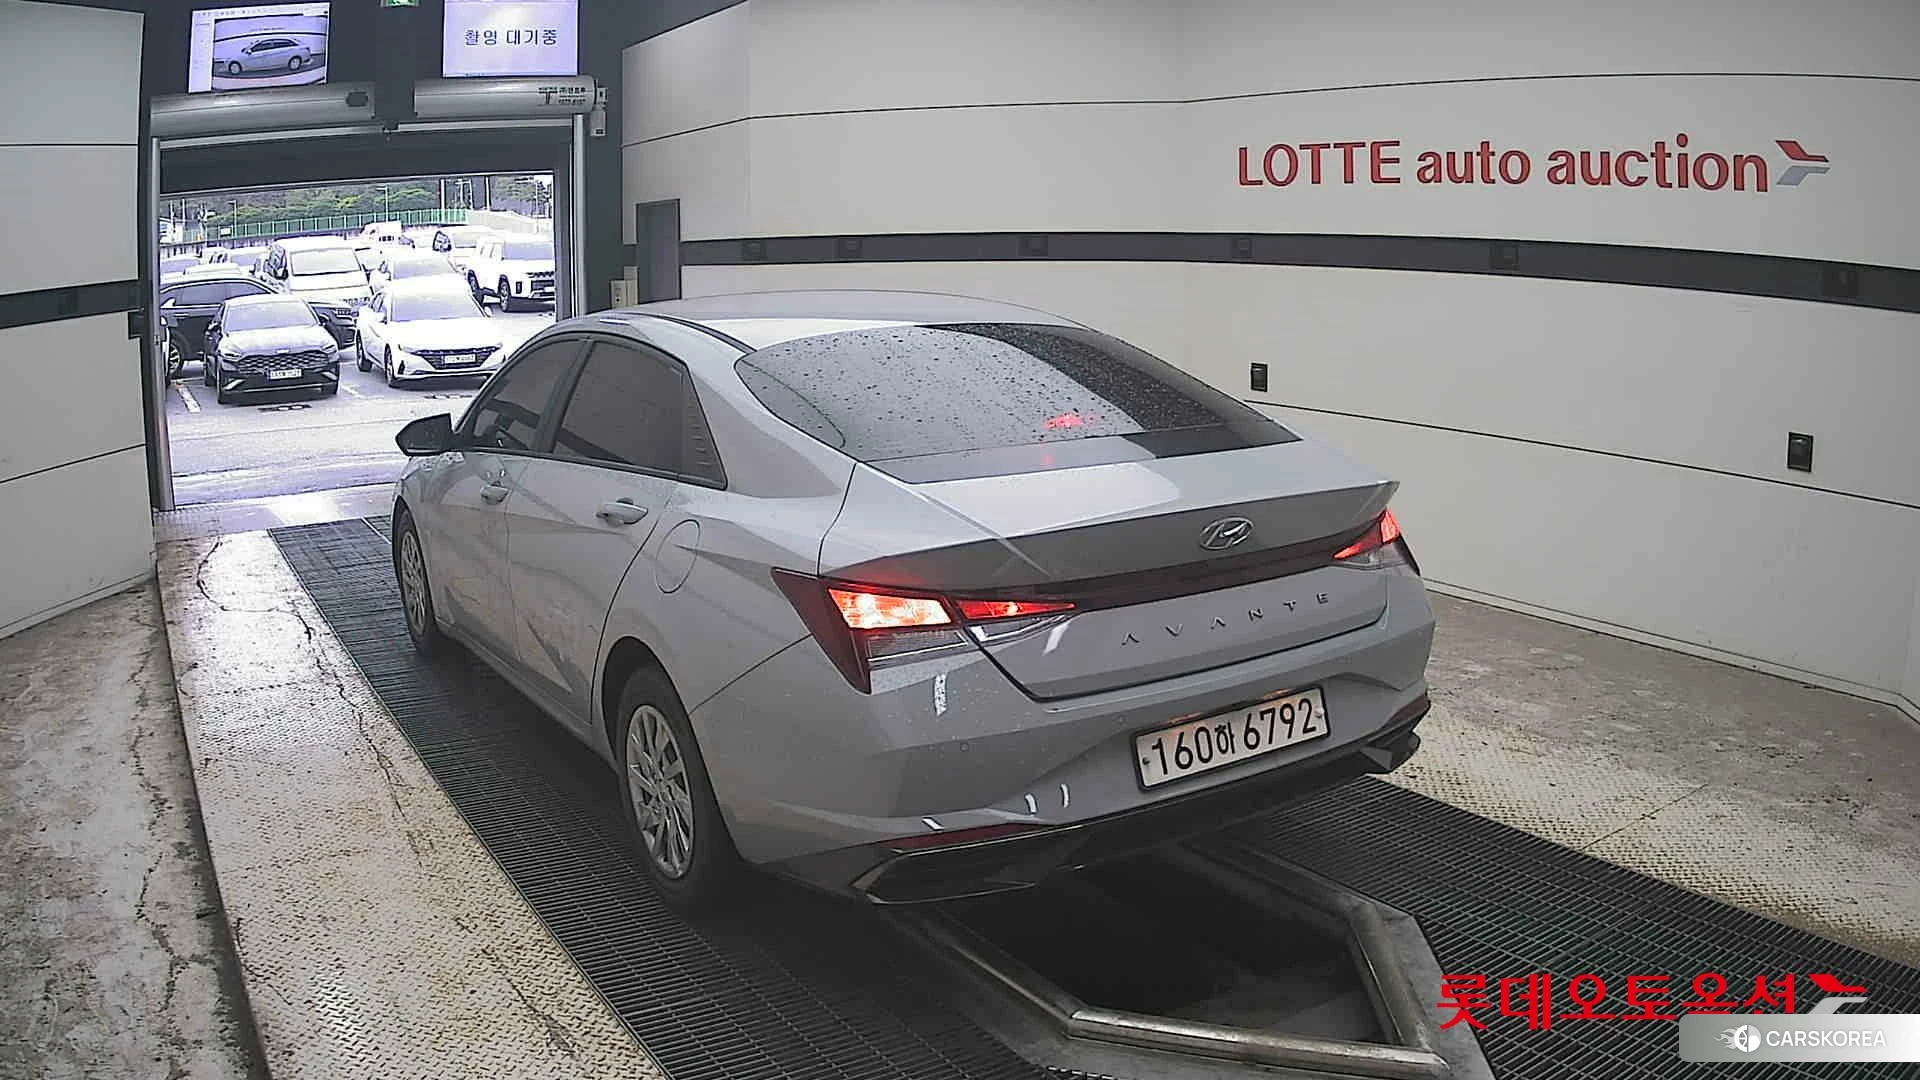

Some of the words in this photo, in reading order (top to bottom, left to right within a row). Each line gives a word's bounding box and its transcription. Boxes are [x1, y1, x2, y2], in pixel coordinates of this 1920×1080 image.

[464, 29, 497, 46] 촬영
[505, 29, 558, 46] 대기중
[1238, 140, 1400, 187] LOTTE
[1416, 140, 1531, 185] auto
[1547, 133, 1769, 193] auction
[1121, 592, 1329, 648] AVANTE
